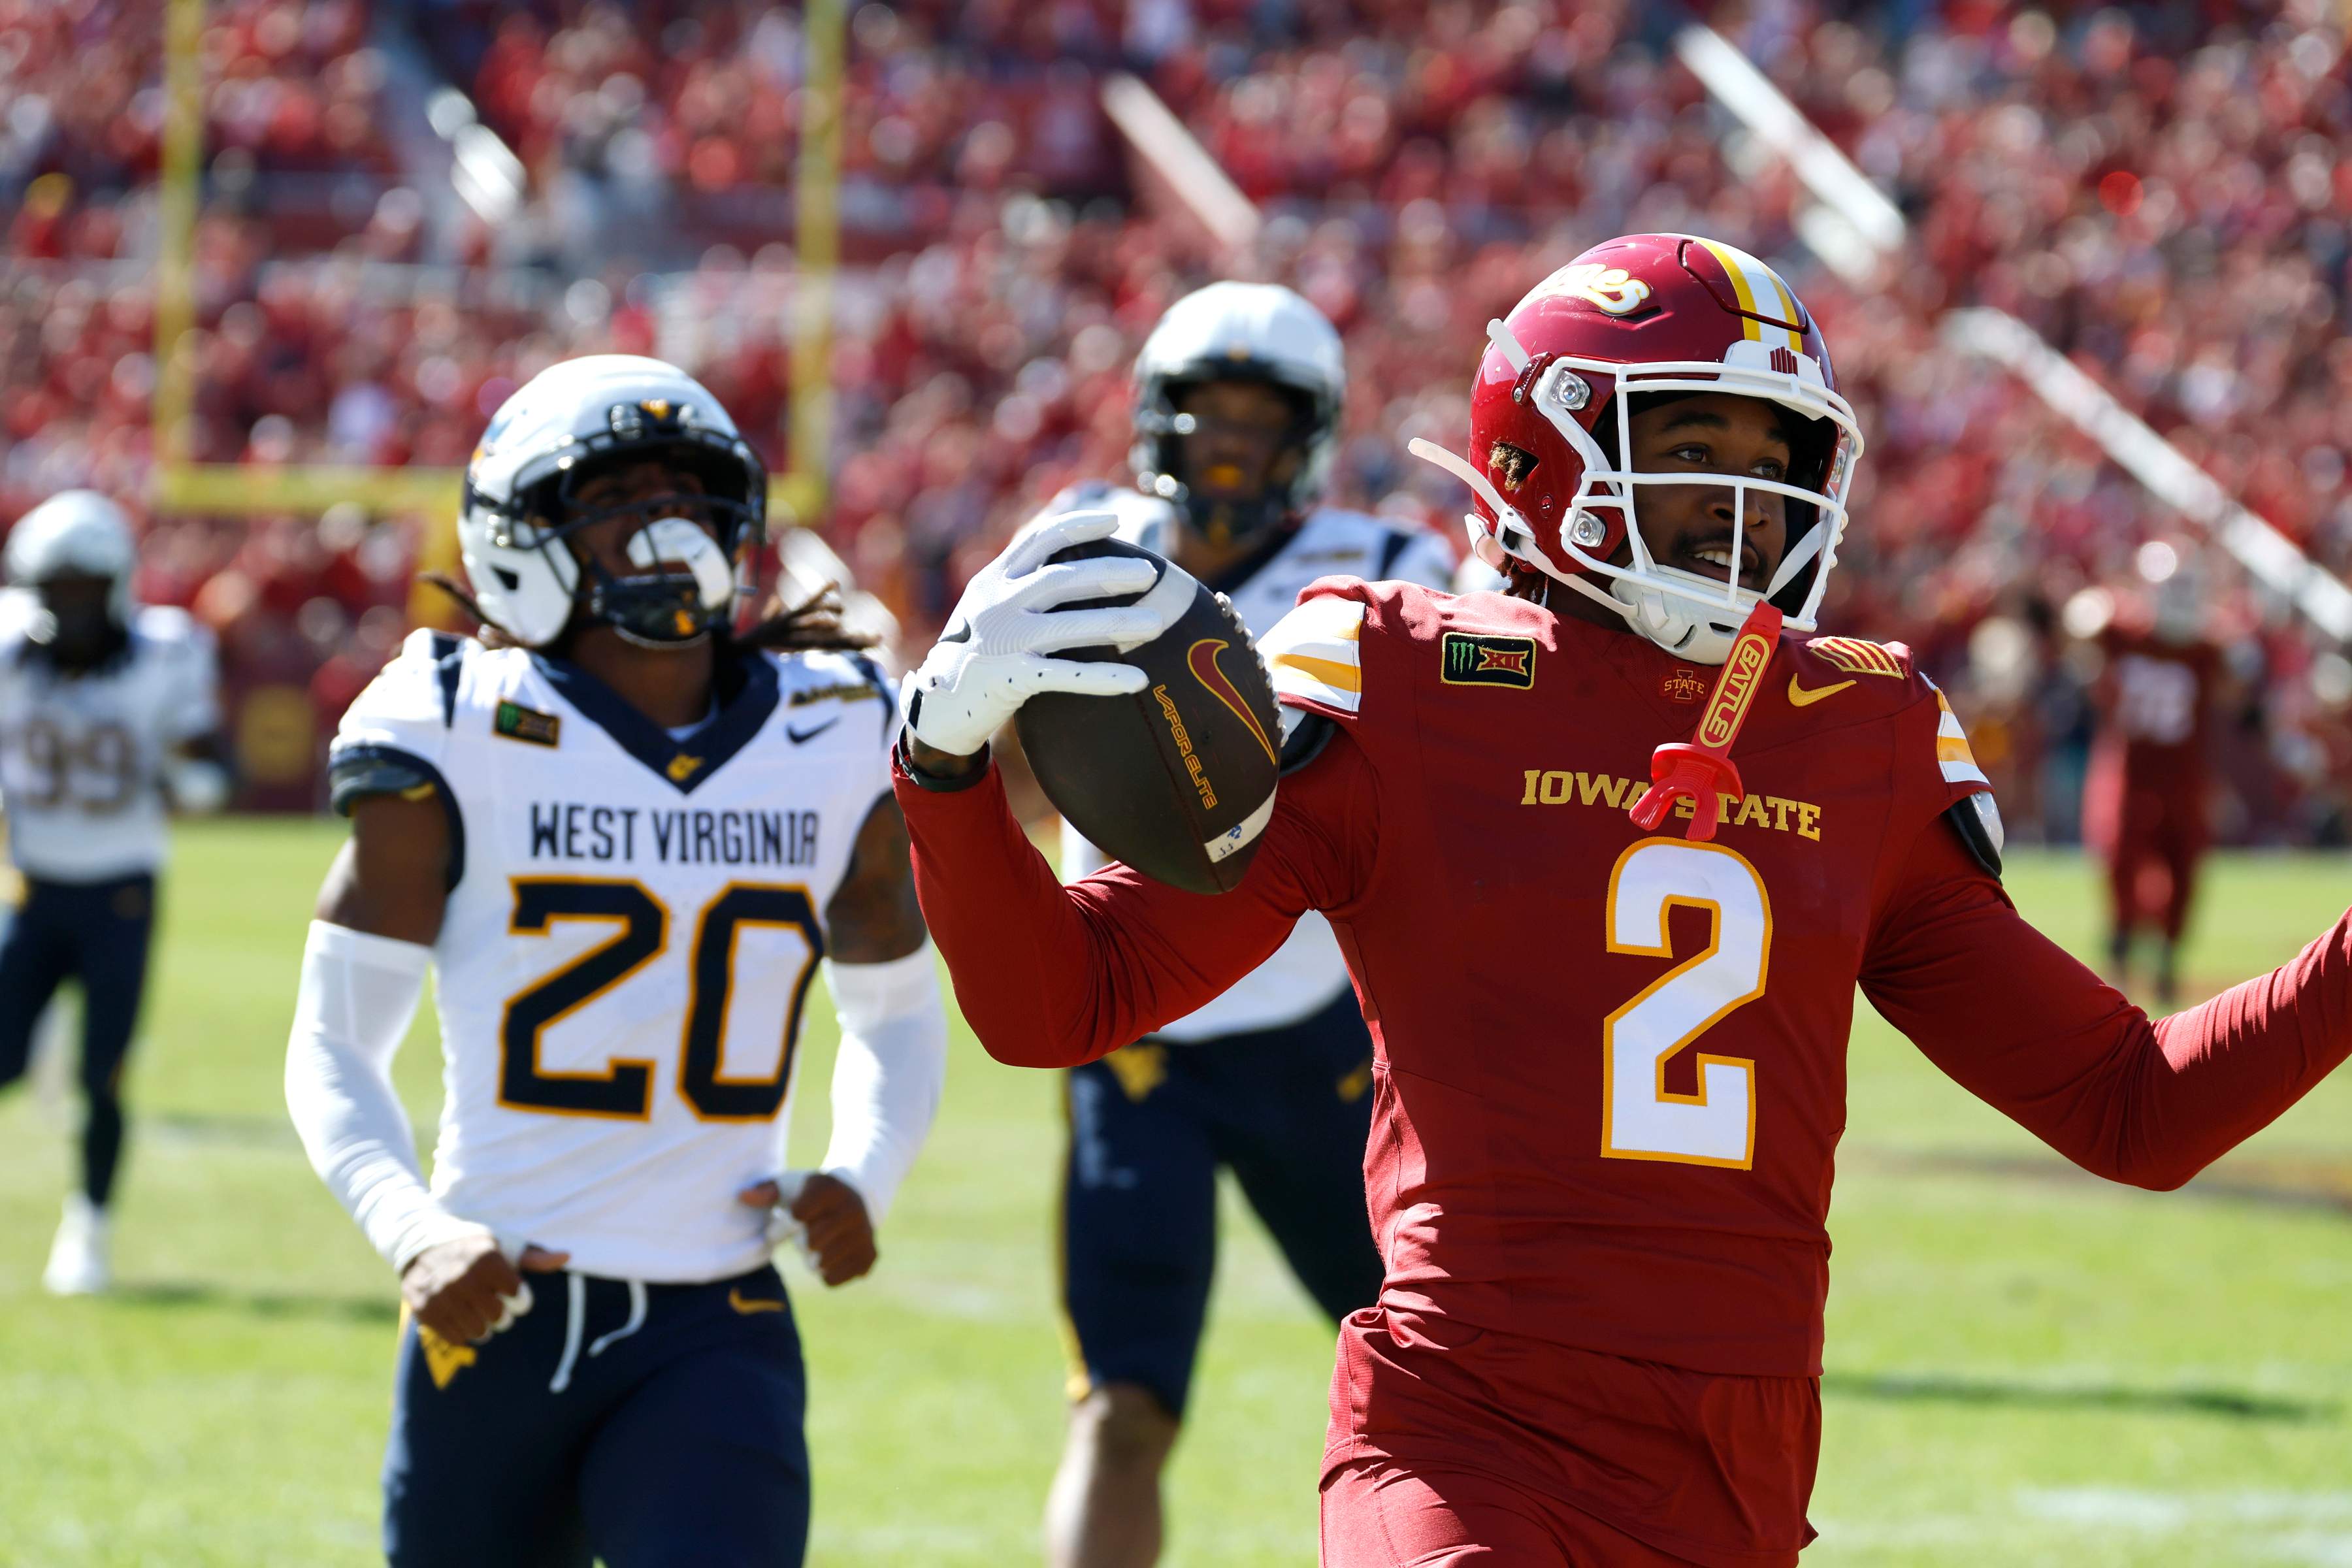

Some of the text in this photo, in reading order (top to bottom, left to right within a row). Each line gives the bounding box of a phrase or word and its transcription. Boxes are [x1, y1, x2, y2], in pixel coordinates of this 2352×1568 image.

[1664, 679, 1705, 694] STATE
[1707, 643, 1761, 738] BATTLE
[1153, 684, 1218, 810] VAPOR ELITE
[531, 803, 821, 868] WEST VIRGINIA
[496, 875, 825, 1124] 20
[1601, 836, 1773, 1171] 2
